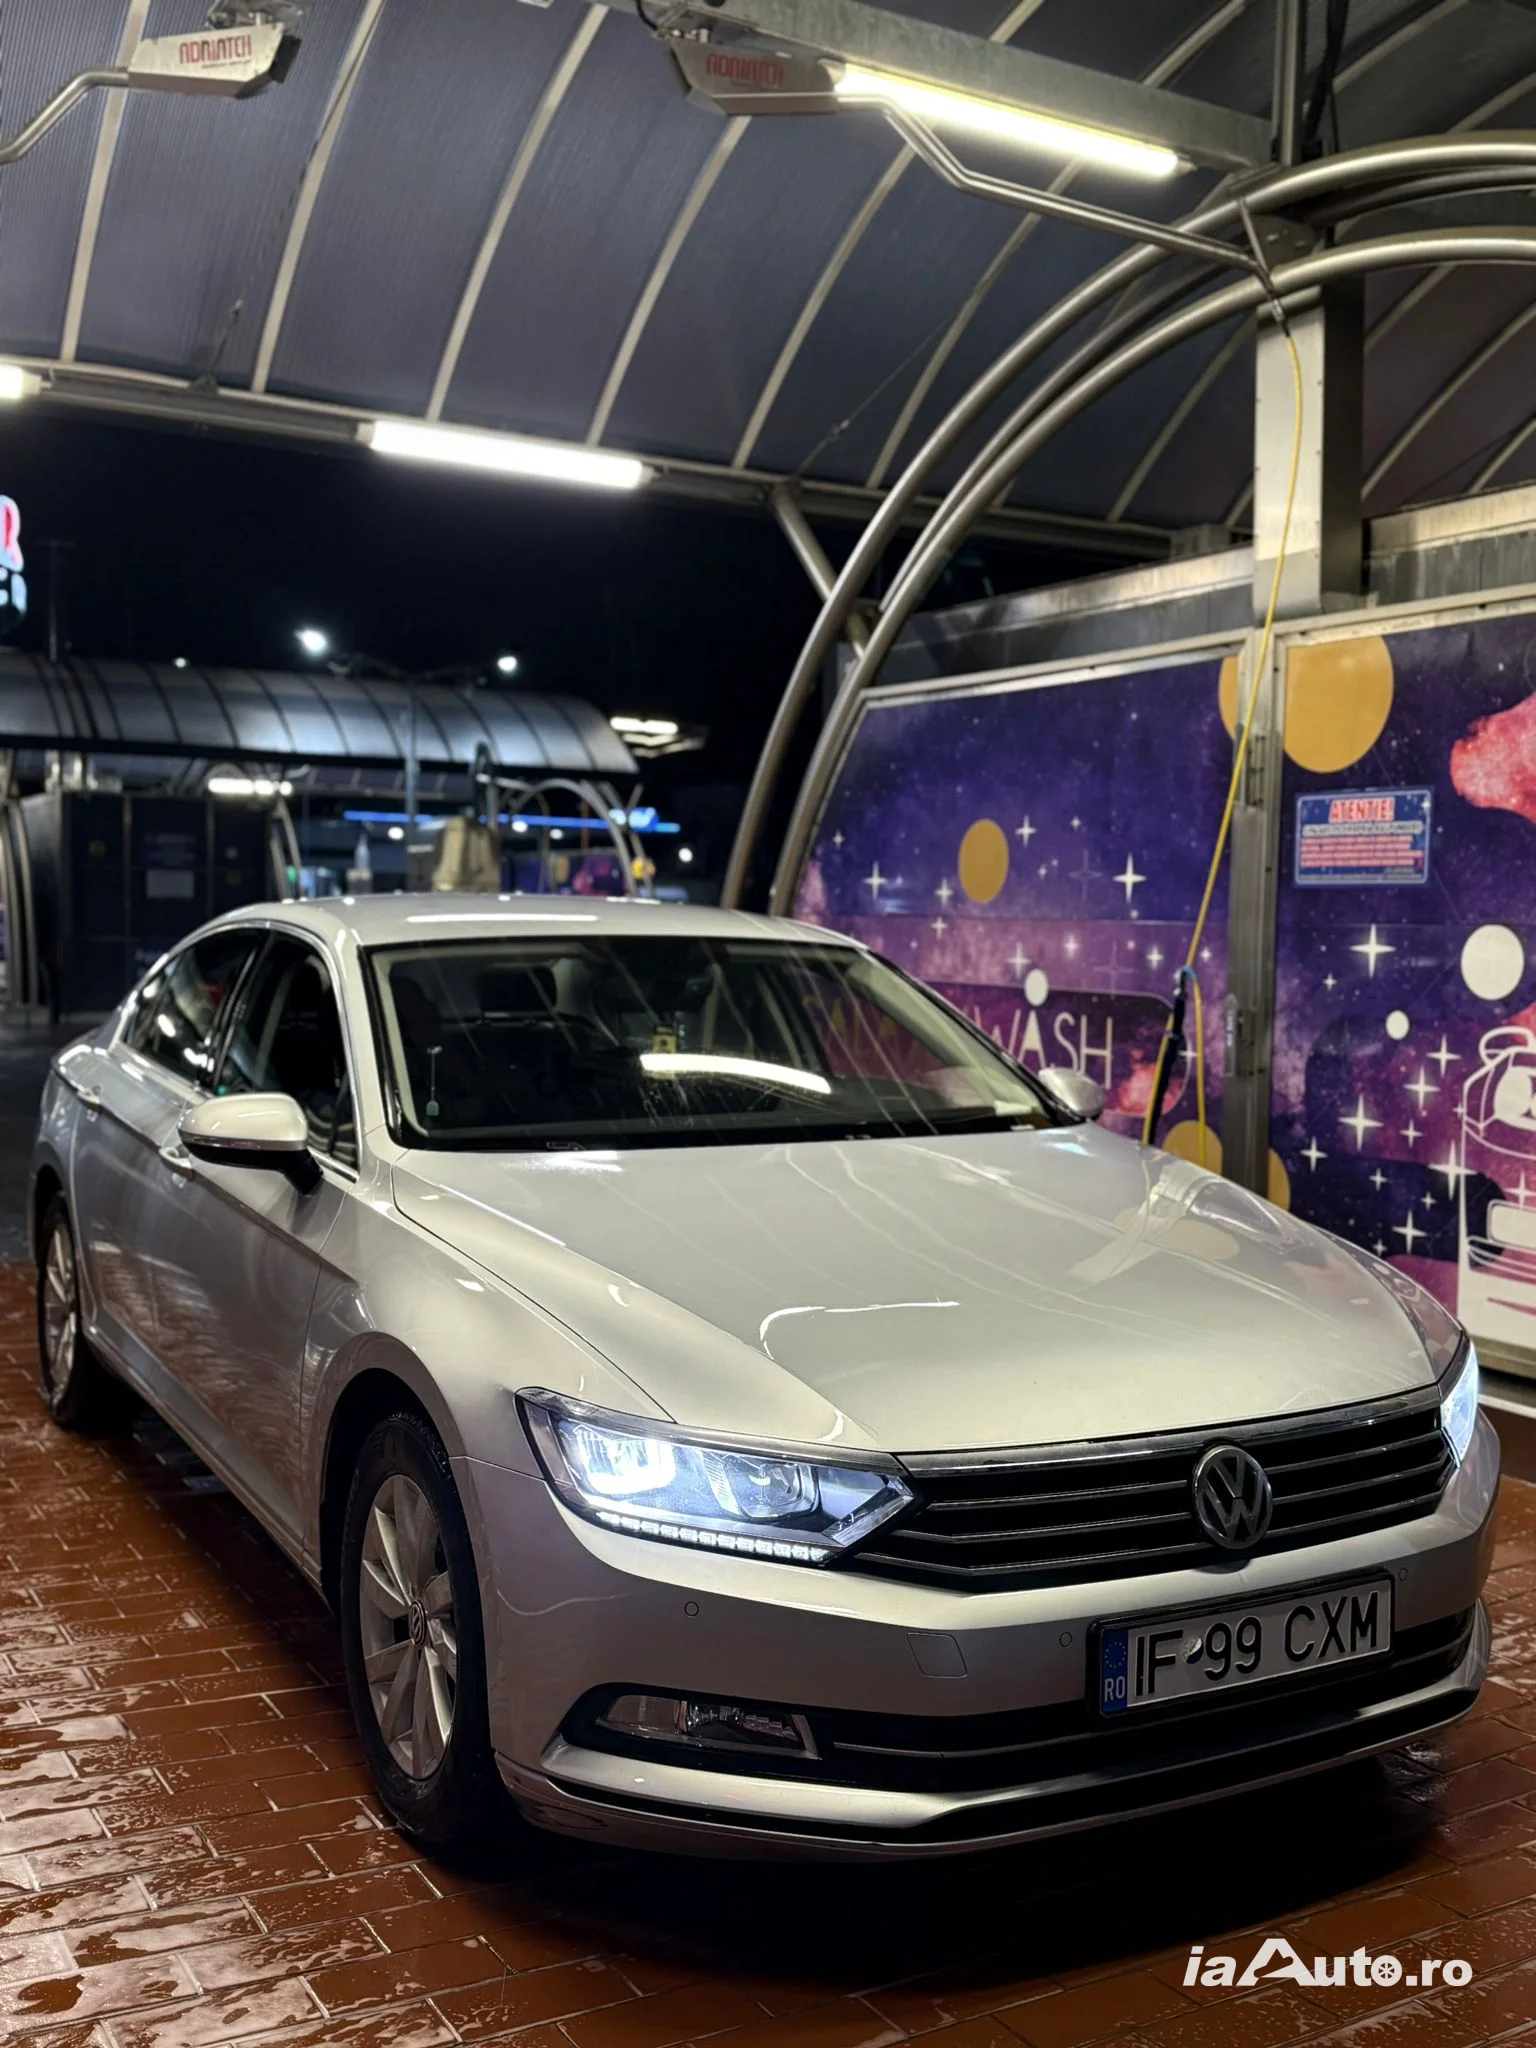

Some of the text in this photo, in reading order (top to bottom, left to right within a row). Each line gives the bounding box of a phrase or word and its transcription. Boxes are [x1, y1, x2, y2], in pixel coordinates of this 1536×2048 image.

[1134, 1591, 1379, 1697] IF 99 CXM
[1104, 1676, 1126, 1702] RO
